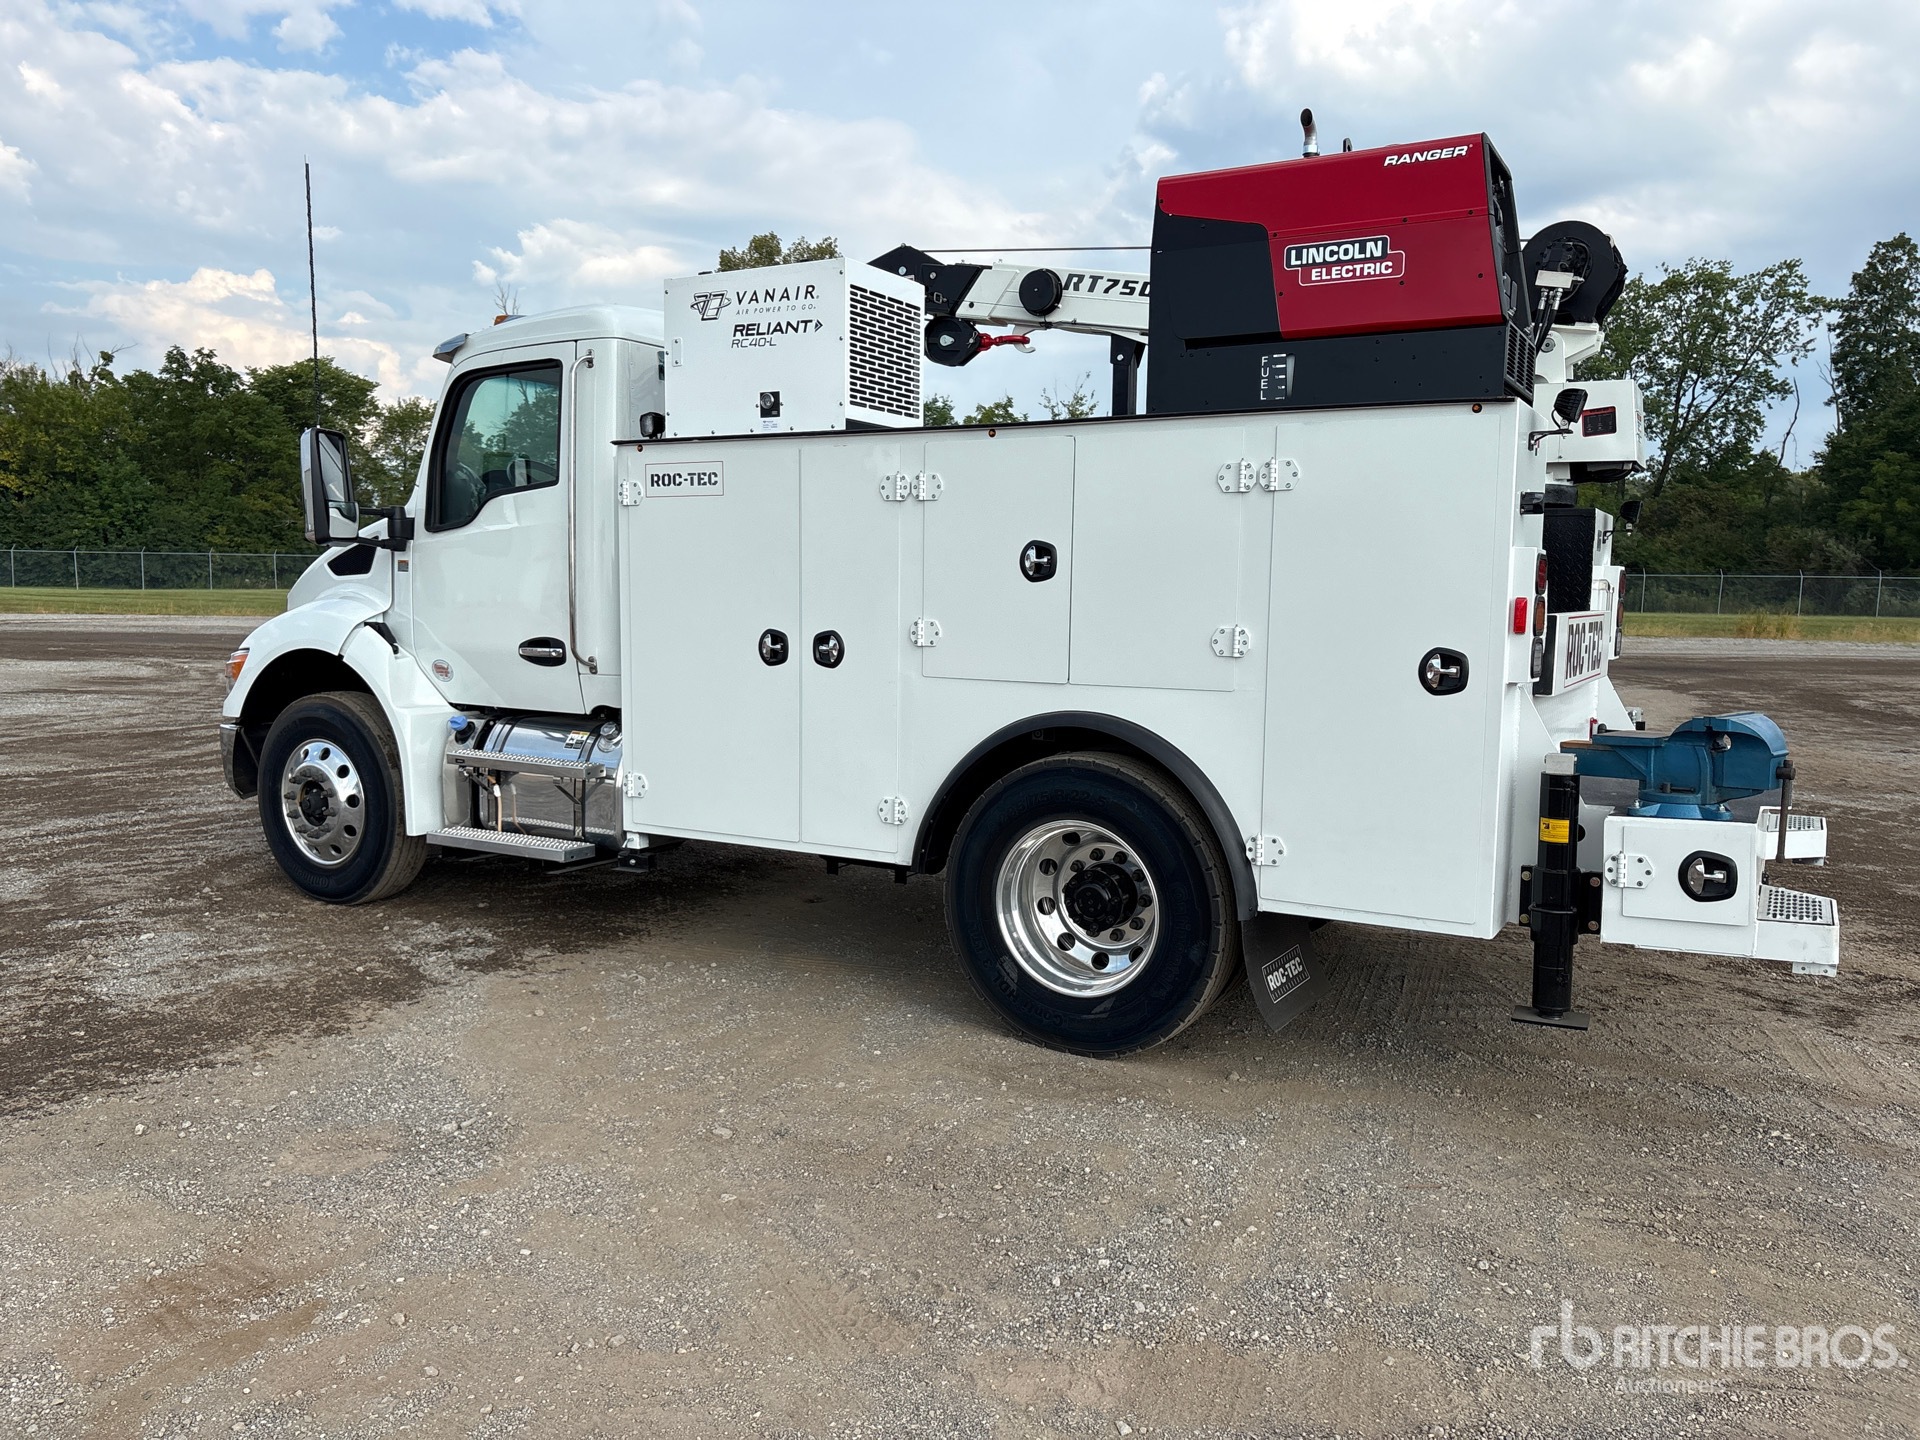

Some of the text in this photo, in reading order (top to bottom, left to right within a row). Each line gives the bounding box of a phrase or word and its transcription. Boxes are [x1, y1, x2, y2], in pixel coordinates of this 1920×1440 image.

[1383, 145, 1468, 167] RANGER
[1290, 240, 1383, 266] LINCOLN
[1311, 261, 1393, 281] ELECTRIC
[736, 284, 816, 305] VANAIR
[753, 305, 781, 314] POWER
[786, 304, 797, 312] TO
[732, 319, 813, 337] RELIANT
[731, 336, 777, 349] RC40-L
[1260, 355, 1270, 400] FUEL
[650, 472, 719, 487] ROC-TEC
[1565, 620, 1603, 680] ROC-TEC
[1267, 956, 1303, 991] ROC-TEC
